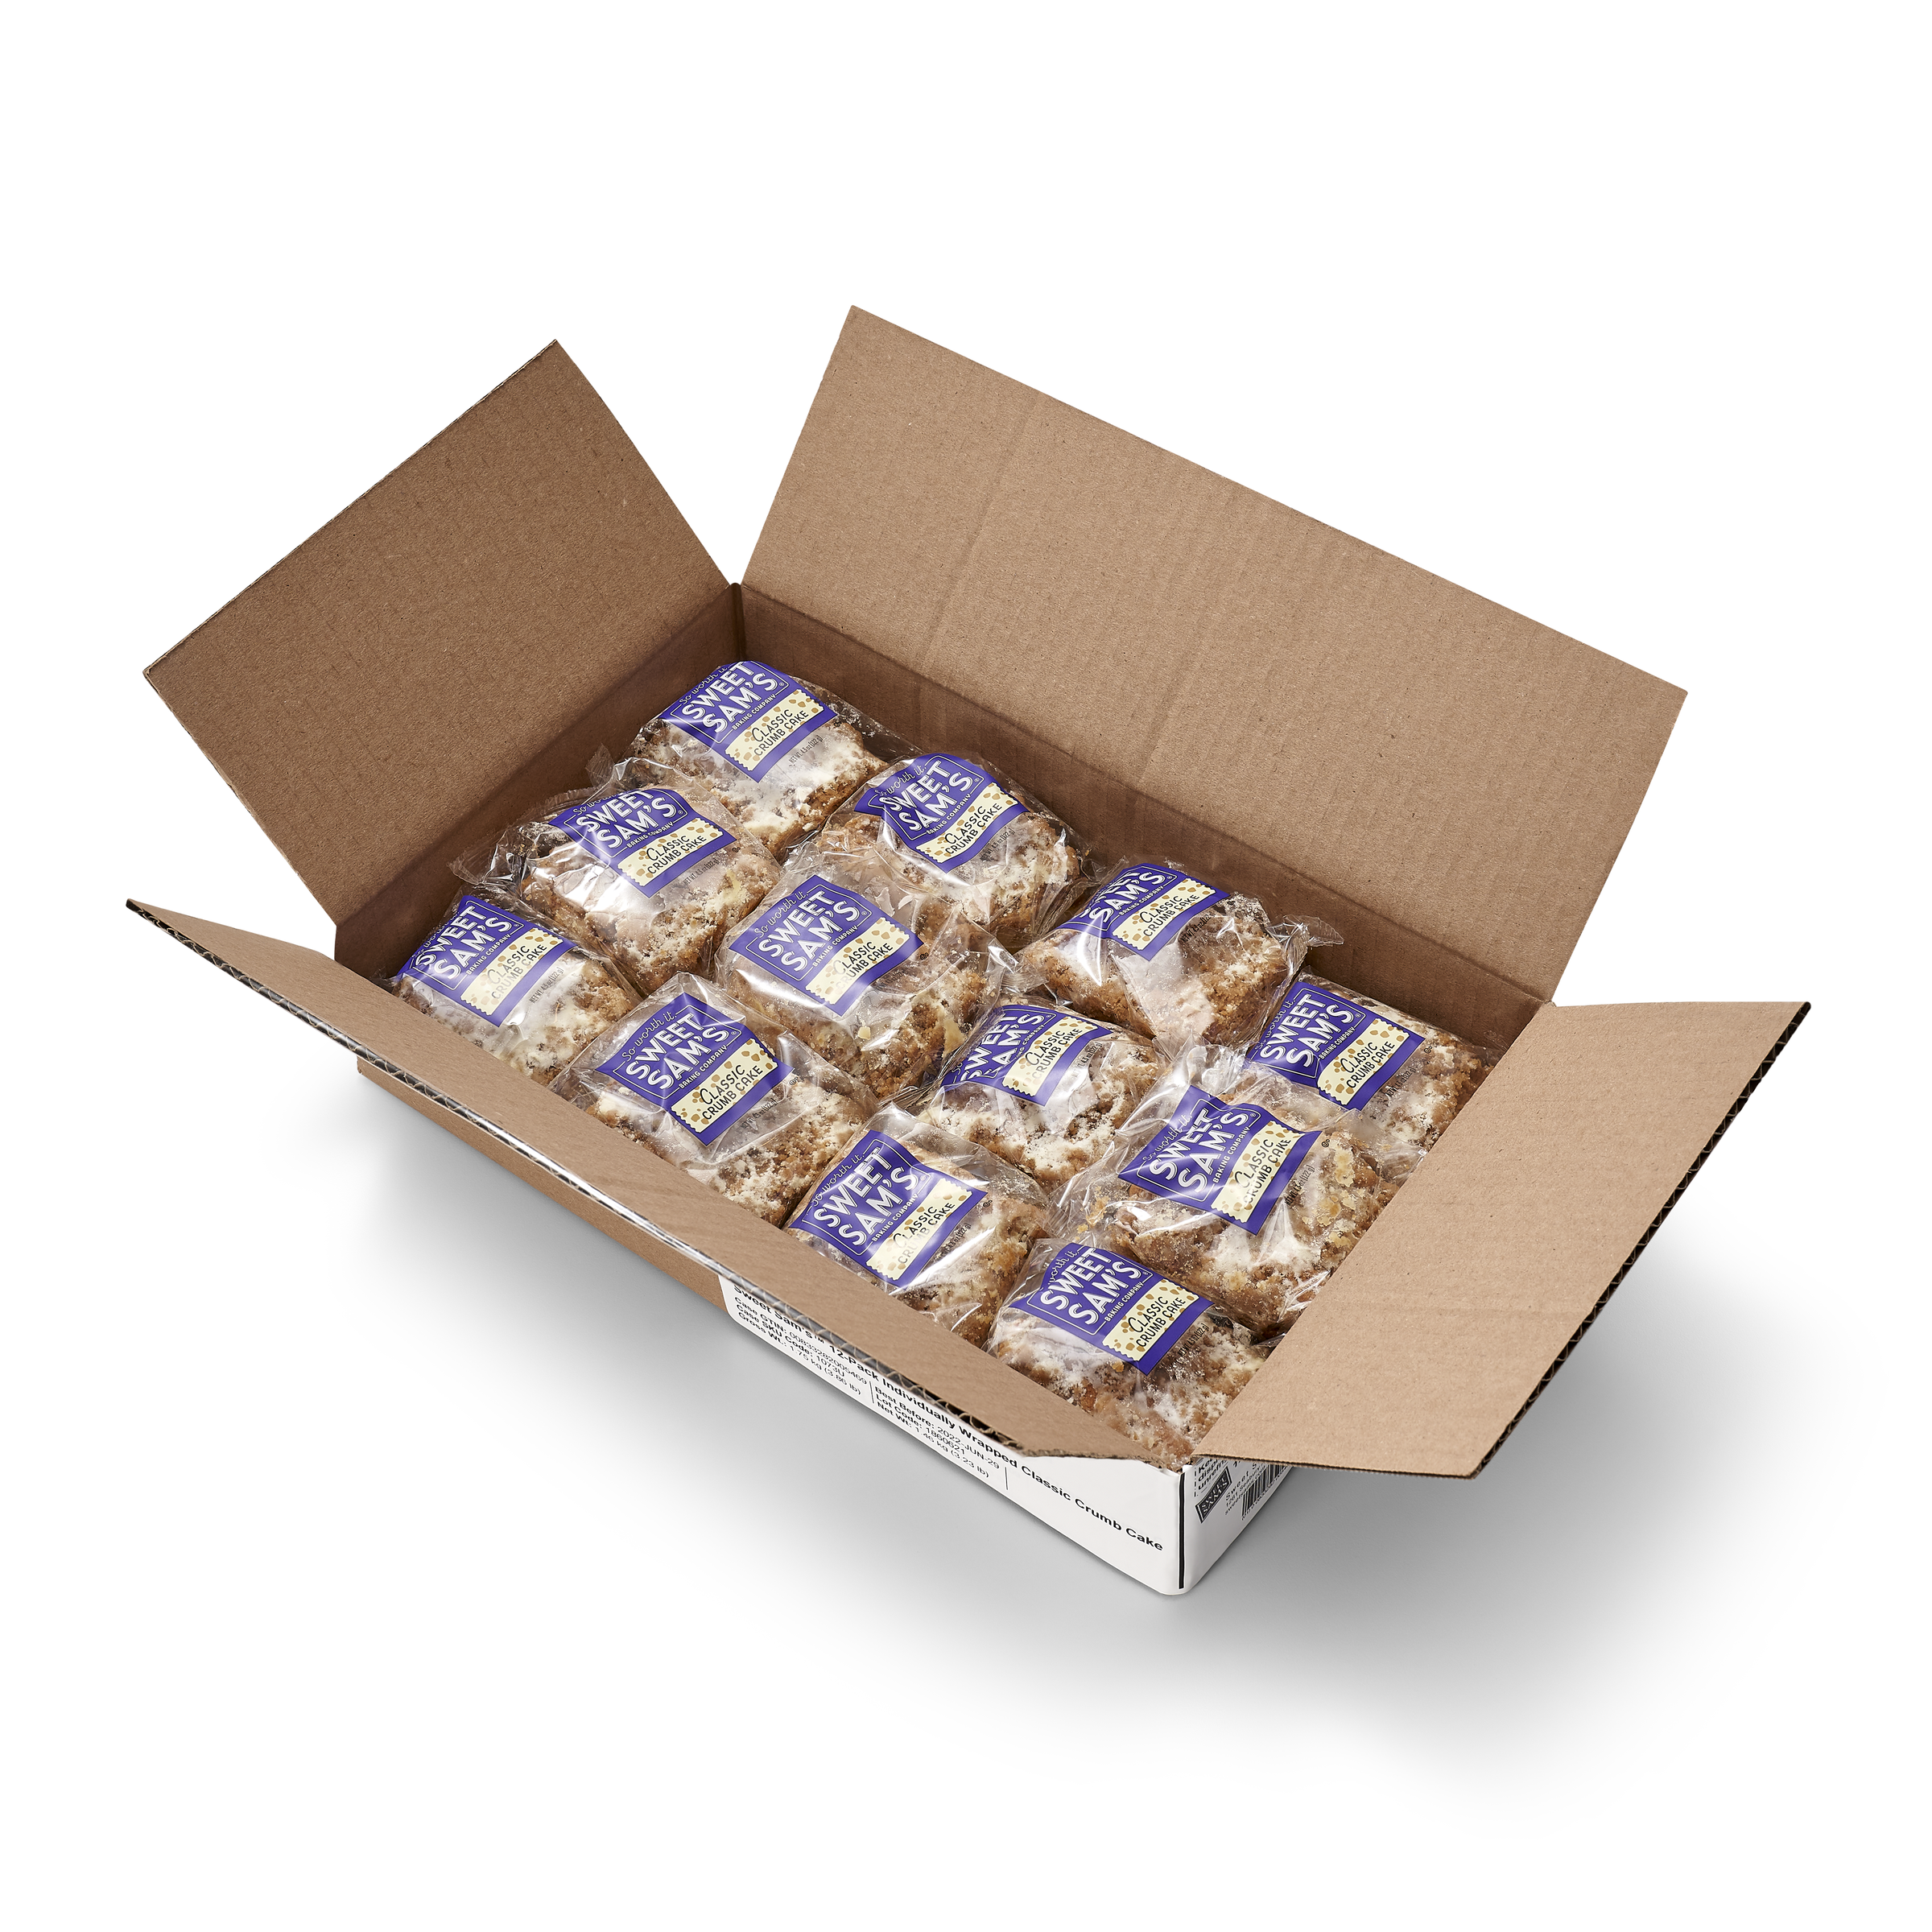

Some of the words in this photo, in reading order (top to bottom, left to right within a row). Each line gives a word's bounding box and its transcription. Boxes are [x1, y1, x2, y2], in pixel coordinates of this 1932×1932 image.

[682, 661, 753, 720] SWEET
[703, 673, 778, 733] SAM'S
[732, 714, 753, 730] BAKING
[751, 694, 776, 714] COMPANY
[752, 709, 792, 741] CLASSIC
[754, 729, 786, 755] CRUMB
[784, 711, 809, 729] CAKE
[879, 760, 950, 811] SWEET
[886, 772, 915, 794] worth
[898, 772, 972, 831] SAM'S
[576, 790, 654, 832] SWEET
[597, 797, 676, 848] SAM'S
[627, 835, 649, 848] BAKING
[648, 822, 673, 836] COMPANY
[926, 819, 947, 834] BAKING
[947, 794, 971, 820] COMPANY
[944, 806, 986, 844] CLASSIC
[945, 829, 978, 854] CRUMB
[977, 803, 1002, 828] CAKE
[646, 836, 690, 861] CLASSIC
[647, 850, 682, 874] CRUMB
[681, 836, 707, 853] CAKE
[754, 925, 769, 938] So
[768, 898, 796, 925] worth
[796, 890, 809, 901] it.
[1089, 872, 1166, 923] SAM'S
[1119, 902, 1140, 915] BAKING
[1139, 886, 1164, 902] COMPANY
[1140, 895, 1183, 923] CLASSIC
[1143, 910, 1175, 936] CRUMB
[1174, 894, 1199, 910] CAKE
[415, 906, 486, 966] SWEET
[435, 916, 512, 977] SAM'S
[758, 890, 835, 957] SWEET
[781, 901, 860, 972] SAM'S
[812, 945, 833, 967] BAKING
[832, 925, 858, 945] COMPANY
[466, 956, 487, 975] BAKING
[485, 934, 511, 956] COMPANY
[487, 946, 530, 985] CLASSIC
[492, 967, 523, 1000] CRUMB
[522, 944, 547, 967] CAKE
[833, 941, 876, 976] CLASSIC
[868, 943, 893, 964] CAKE
[621, 1046, 635, 1061] So
[635, 1018, 664, 1046] worth
[664, 1012, 677, 1022] it.
[625, 1013, 704, 1080] SWEET
[1026, 1030, 1065, 1065] CLASSIC
[1260, 993, 1327, 1059] SWEET
[1286, 1005, 1354, 1067] SAM'S
[1319, 1044, 1336, 1059] BAKING
[1335, 1026, 1356, 1045] COMPANY
[647, 1026, 729, 1089] SAM'S
[679, 1071, 700, 1088] BAKING
[700, 1045, 727, 1071] COMPANY
[1032, 1046, 1061, 1079] CRUMB
[1059, 1028, 1083, 1046] CAKE
[1340, 1042, 1377, 1073] CLASSIC
[1347, 1062, 1375, 1088] CRUMB
[1372, 1042, 1395, 1063] CAKE
[700, 1064, 745, 1104] CLASSIC
[703, 1091, 737, 1120] CRUMB
[735, 1065, 763, 1092] CAKE
[1150, 1108, 1220, 1180] SWEET
[1178, 1112, 1249, 1193] SAM'S
[1212, 1155, 1231, 1183] BAKING
[1228, 1126, 1250, 1154] COMPANY
[1235, 1139, 1274, 1188] CLASSIC
[1268, 1138, 1291, 1163] CAKE
[814, 1147, 891, 1227] SWEET
[822, 1164, 852, 1192] worth
[852, 1154, 865, 1163] it.
[838, 1166, 919, 1245] SAM'S
[872, 1221, 894, 1241] BAKING
[893, 1193, 919, 1221] COMPANY
[893, 1206, 938, 1248] CLASSIC
[928, 1203, 955, 1225] CAKE
[1040, 1248, 1111, 1310] SWEET
[1068, 1261, 1141, 1325] SAM'S
[1105, 1302, 1124, 1322] BAKING
[1124, 1282, 1144, 1302] COMPANY
[735, 1297, 758, 1315] Case
[761, 1315, 786, 1334] GTIN:
[1129, 1297, 1168, 1332] CLASSIC
[1136, 1320, 1166, 1348] CRUMB
[1162, 1298, 1186, 1319] CAKE
[737, 1305, 759, 1322] Case
[762, 1321, 782, 1336] SKU
[784, 1335, 813, 1356] Code:
[816, 1356, 844, 1377] 1073U
[739, 1312, 766, 1333] Gross
[791, 1346, 808, 1360] 1.75
[811, 1359, 821, 1370] kg
[849, 1383, 861, 1394] lb)
[734, 1285, 771, 1313] Sweet
[829, 1345, 879, 1381] 12-Pack
[882, 1378, 956, 1429] Individually
[958, 1425, 1018, 1468] Wrapped
[1022, 1465, 1071, 1501] Classic
[1075, 1499, 1121, 1531] Crumb
[1127, 1528, 1163, 1550] Cake
[875, 1386, 897, 1404] Best
[899, 1402, 934, 1429] Before:
[937, 1426, 999, 1468] 2022-JUN-29
[877, 1394, 892, 1408] Lot
[894, 1406, 922, 1428] Code:
[926, 1427, 964, 1455] 1860621
[877, 1402, 894, 1416] Net
[915, 1427, 934, 1442] 1.46
[937, 1441, 947, 1451] kg
[951, 1451, 974, 1468] (3.23
[977, 1466, 989, 1477] lb)
